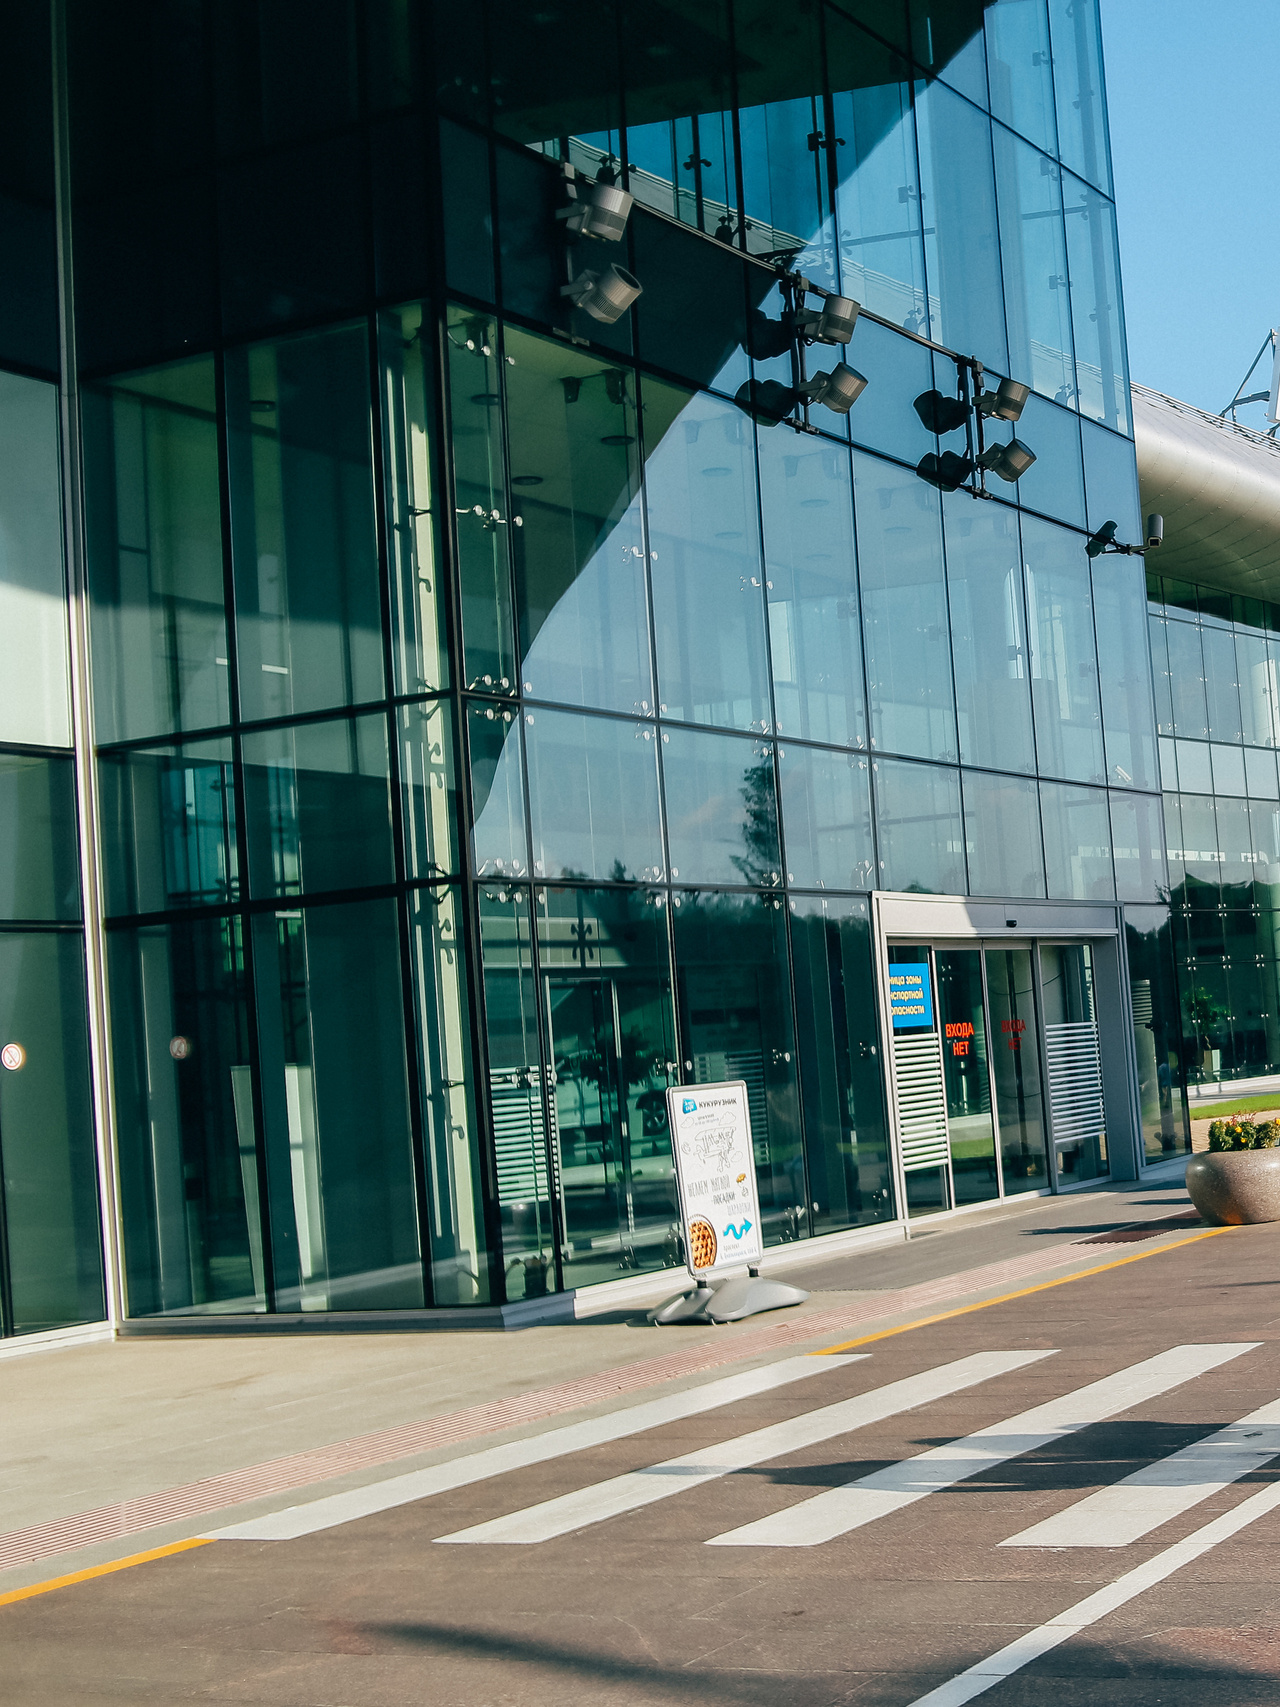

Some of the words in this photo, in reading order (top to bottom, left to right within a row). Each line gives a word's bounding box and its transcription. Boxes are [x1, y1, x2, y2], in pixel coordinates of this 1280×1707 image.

[905, 975, 921, 984] зоны
[945, 1022, 974, 1037] ВХОДА
[1001, 1019, 1026, 1033] ВХОДА
[953, 1041, 969, 1056] НЕТ
[1008, 1037, 1022, 1050] НЕТ
[698, 1098, 736, 1108] КУКУРУЗНИК
